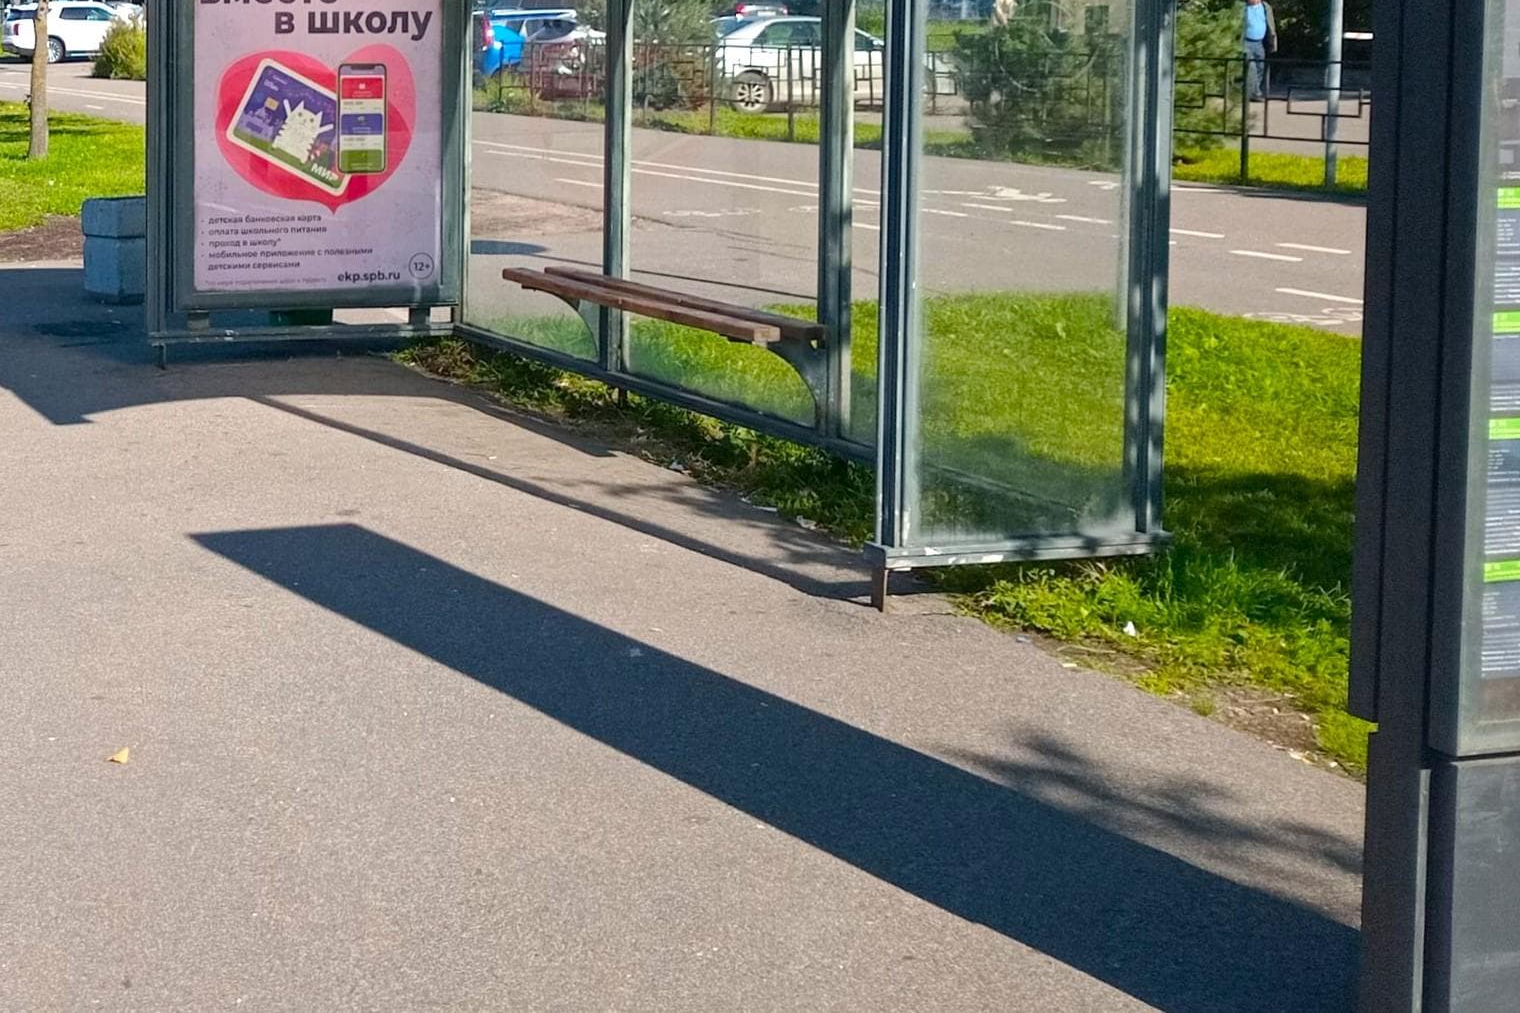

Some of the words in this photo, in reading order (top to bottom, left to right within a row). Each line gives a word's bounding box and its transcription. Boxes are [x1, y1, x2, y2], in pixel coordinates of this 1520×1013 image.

[275, 11, 295, 34] в
[308, 11, 433, 41] школу
[208, 216, 243, 225] детская
[245, 215, 295, 224] банковская
[297, 214, 322, 223] карта
[208, 228, 239, 236] оплата
[241, 226, 289, 235] школьного
[291, 226, 328, 234] питания
[208, 249, 258, 259] мобильное
[260, 249, 316, 258] приложение
[324, 247, 373, 256] полезными
[207, 262, 251, 272] детскими
[252, 261, 301, 270] сервисами
[413, 261, 430, 272] 12+
[337, 270, 401, 284] ekp.spb.ru
